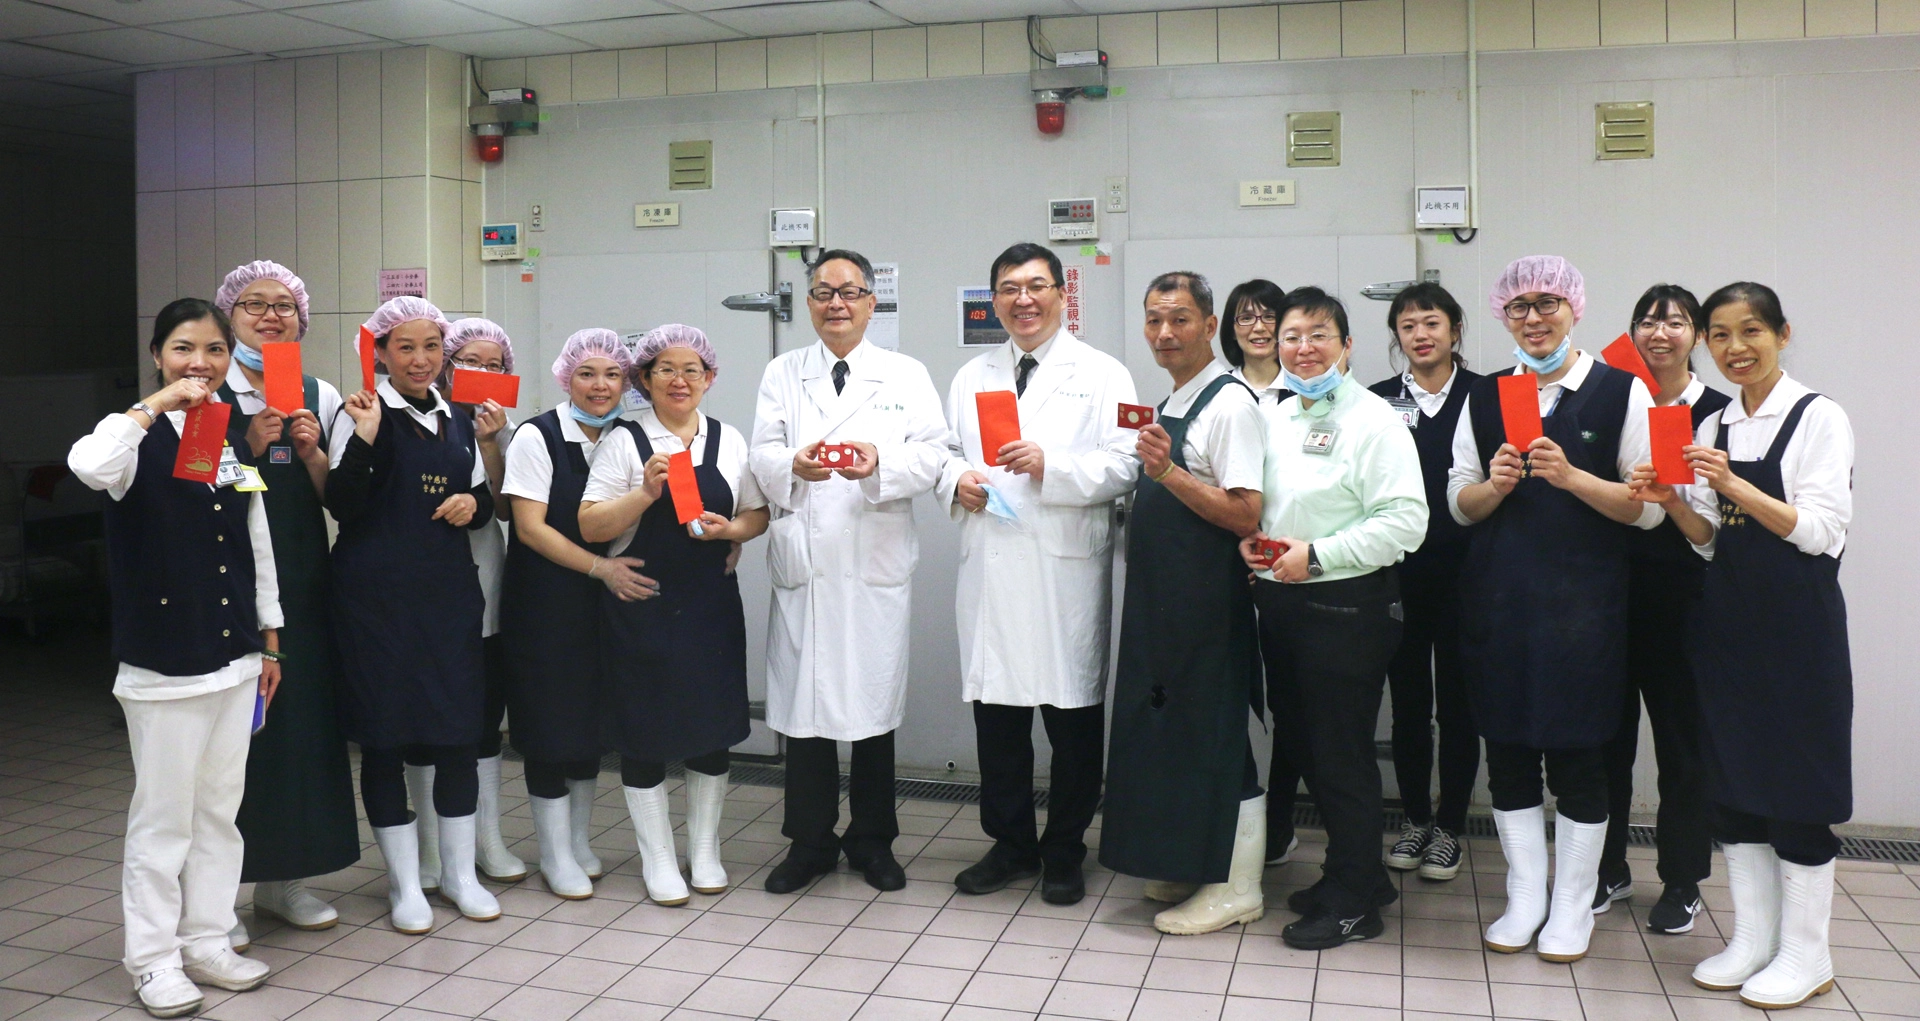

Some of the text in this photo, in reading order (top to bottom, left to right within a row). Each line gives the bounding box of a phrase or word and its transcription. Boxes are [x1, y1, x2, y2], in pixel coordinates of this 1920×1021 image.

[1250, 185, 1286, 195] 冷藏庫
[1424, 202, 1459, 210] 此機不用
[642, 208, 671, 217] 冷凍庫
[781, 223, 809, 231] 此機不用
[1066, 268, 1079, 334] 錄影監視中
